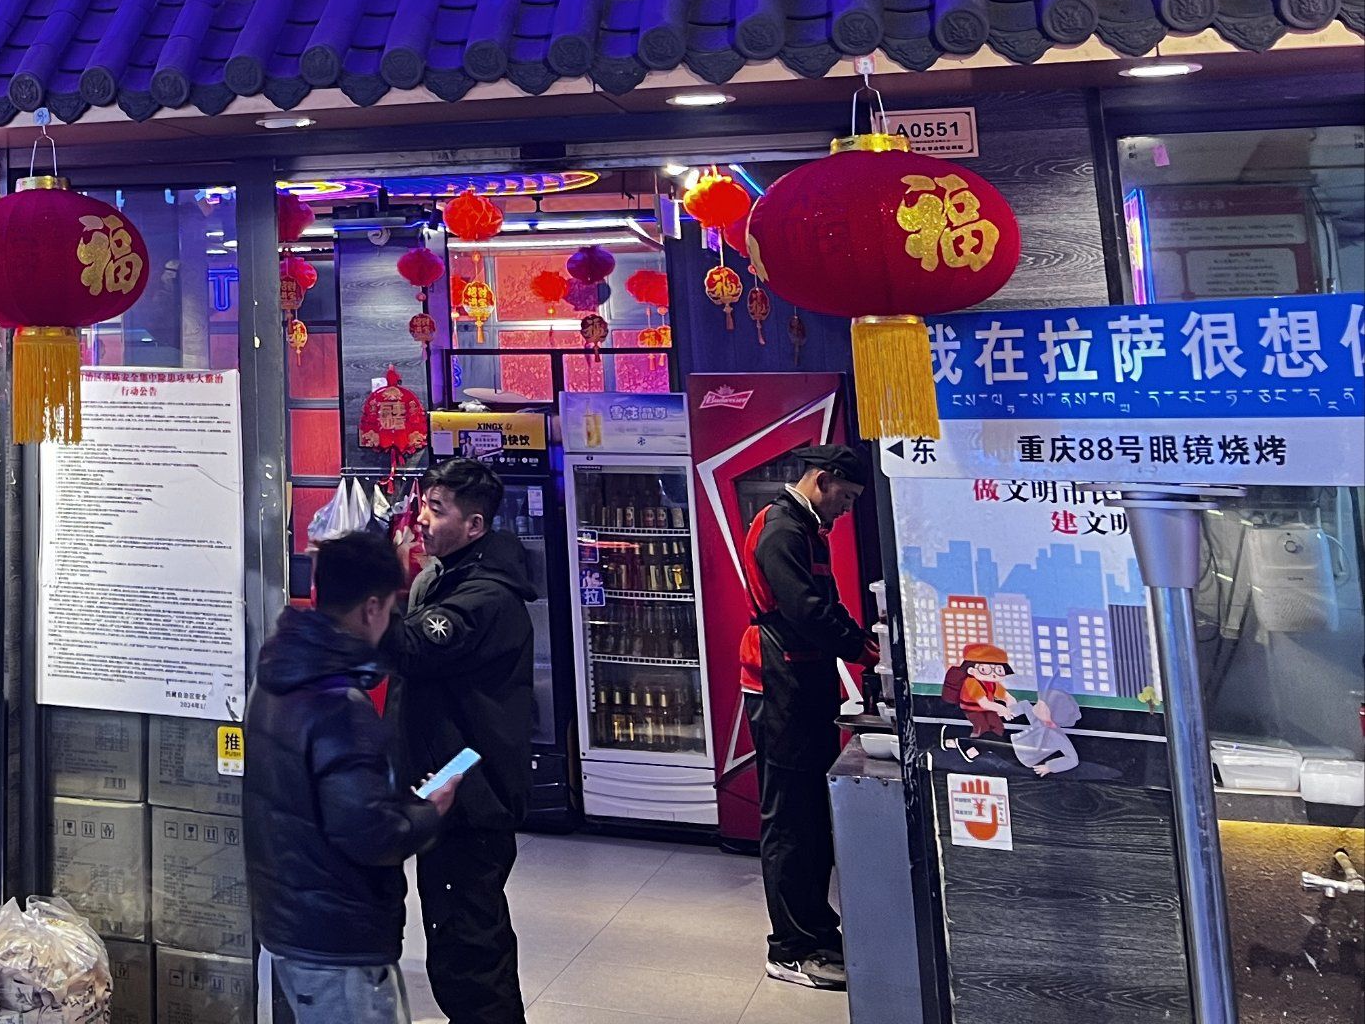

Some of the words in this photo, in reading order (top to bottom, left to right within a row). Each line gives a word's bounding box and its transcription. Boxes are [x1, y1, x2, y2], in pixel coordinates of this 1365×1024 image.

[896, 121, 960, 138] A0551
[895, 173, 1001, 273] 福
[76, 215, 144, 296] 福
[80, 370, 224, 384] 治区消防安全集中除患攻坚大整治
[121, 386, 158, 397] 行动公告
[911, 436, 938, 464] 东
[1017, 435, 1287, 465] 重庆88号眼镜烧烤
[224, 732, 241, 751] 推
